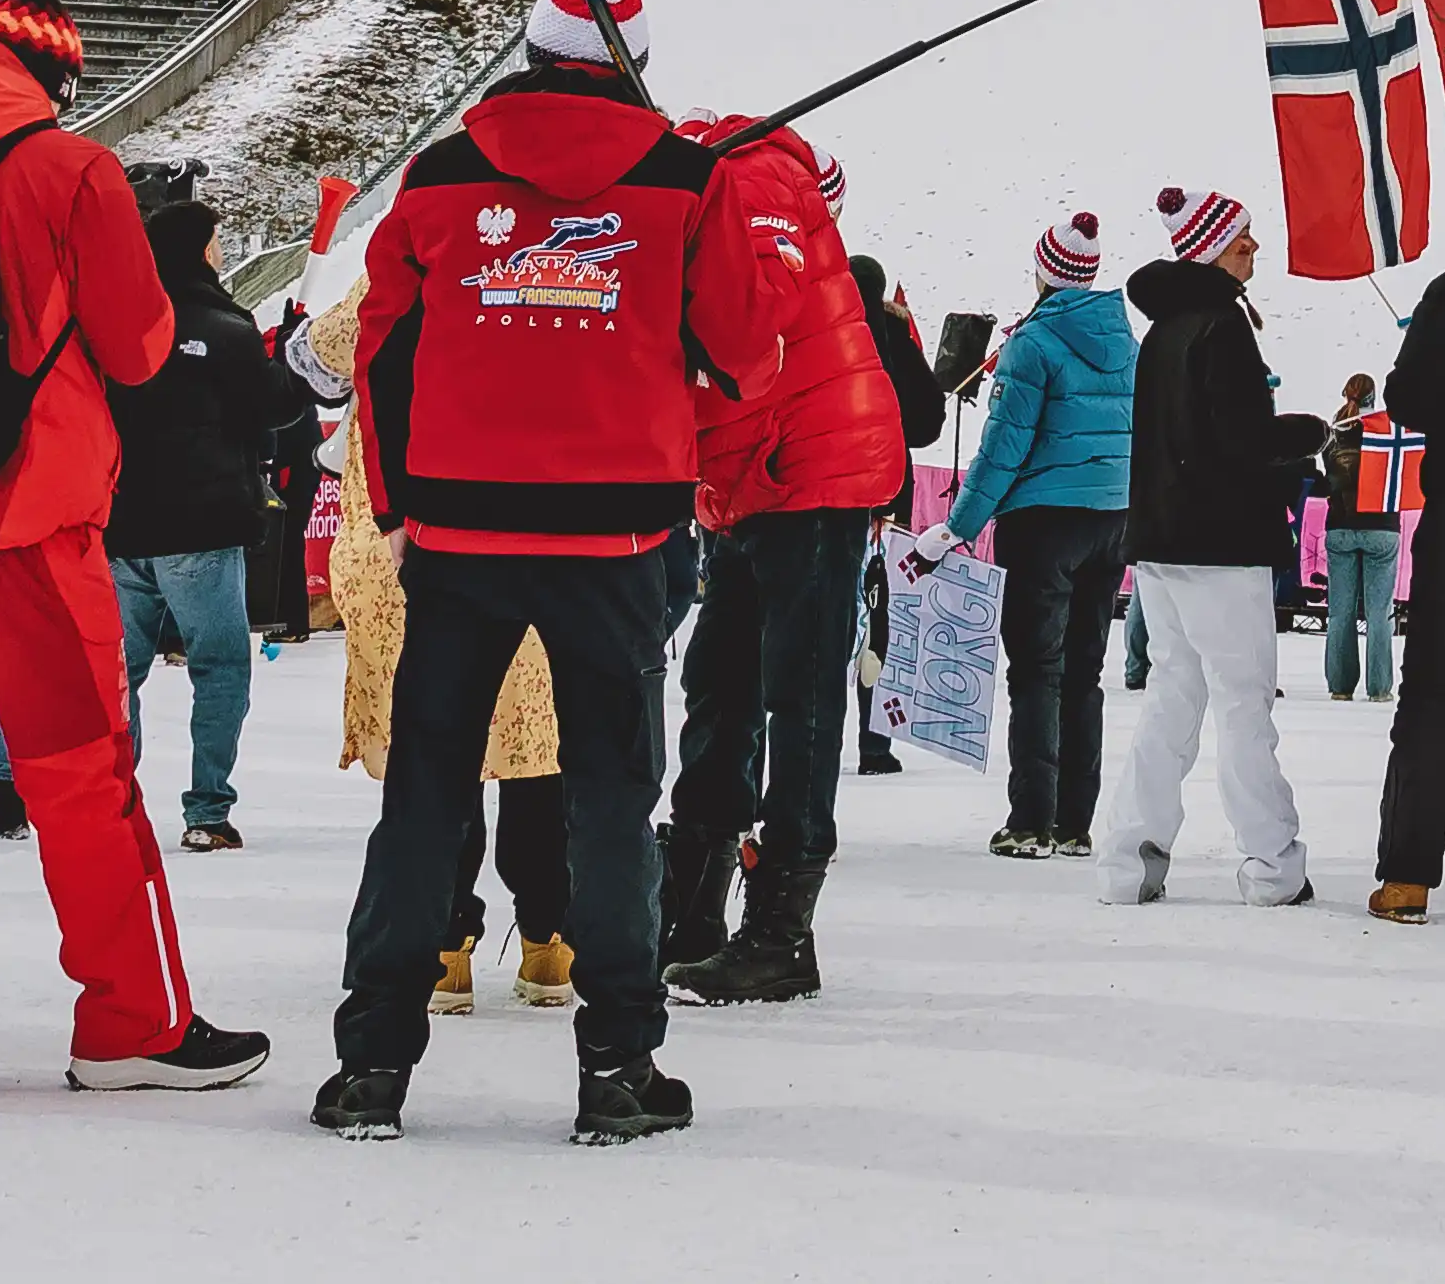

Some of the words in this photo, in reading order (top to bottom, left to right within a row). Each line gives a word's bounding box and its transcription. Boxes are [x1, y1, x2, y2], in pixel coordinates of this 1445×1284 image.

[476, 314, 615, 331] POLSKA
[314, 478, 341, 509] ges
[878, 592, 923, 697] HEIA
[910, 550, 1002, 762] NORGE
